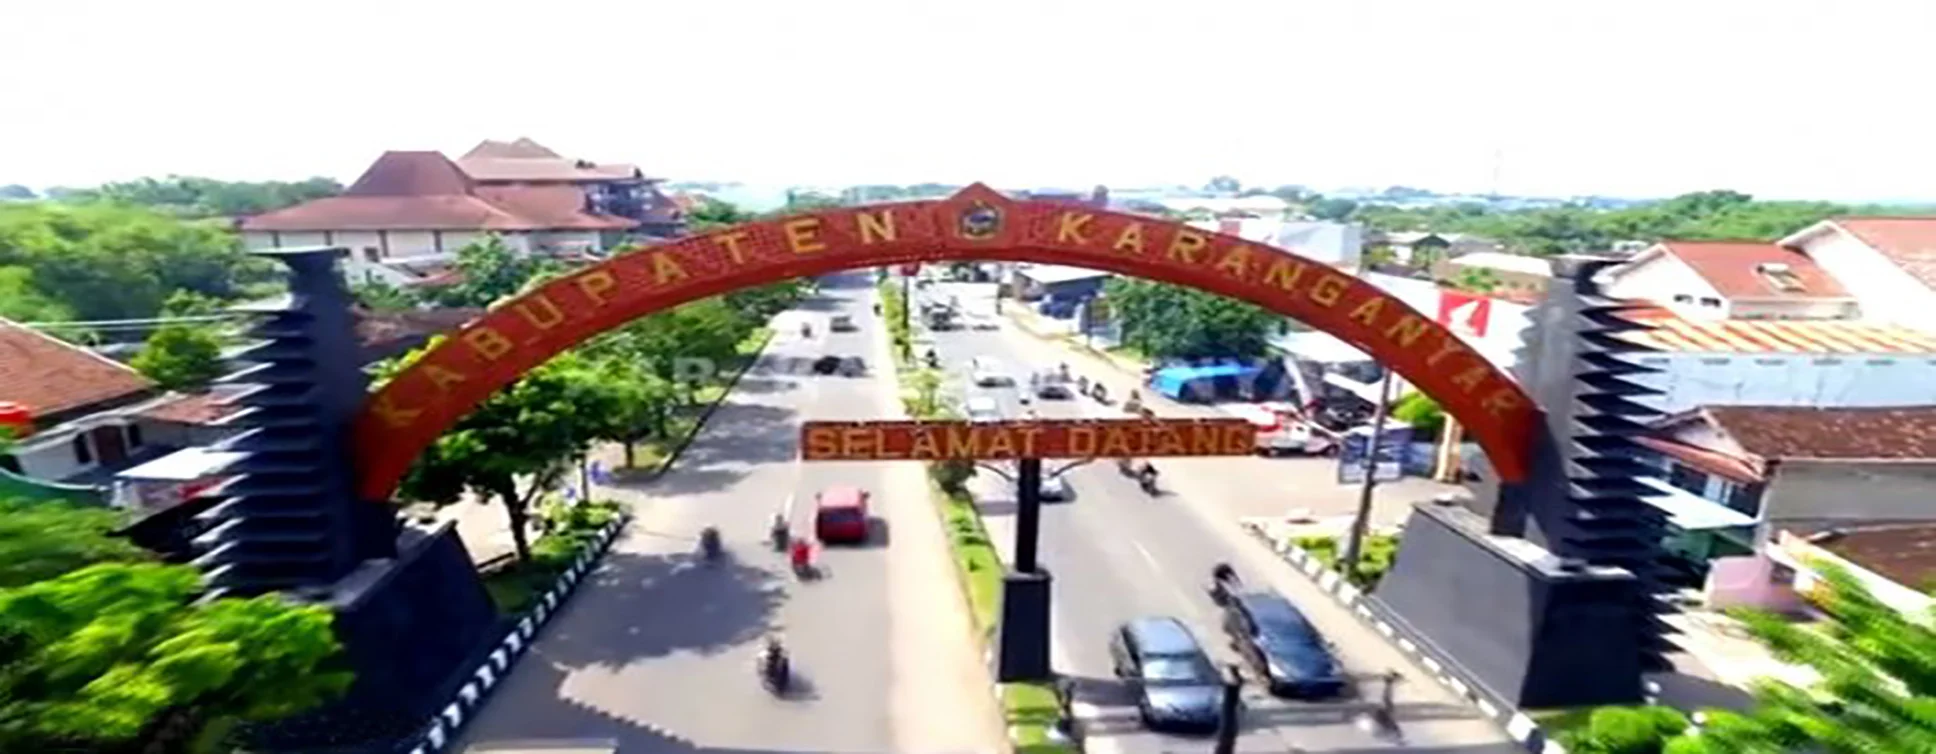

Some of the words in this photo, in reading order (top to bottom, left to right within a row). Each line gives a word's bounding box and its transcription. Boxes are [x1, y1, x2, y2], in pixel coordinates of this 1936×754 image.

[373, 209, 896, 427] KABUPATEN
[1056, 212, 1518, 415] KARANGANYAR
[806, 426, 1044, 458] SELAMAT
[1068, 424, 1250, 456] DATANG
